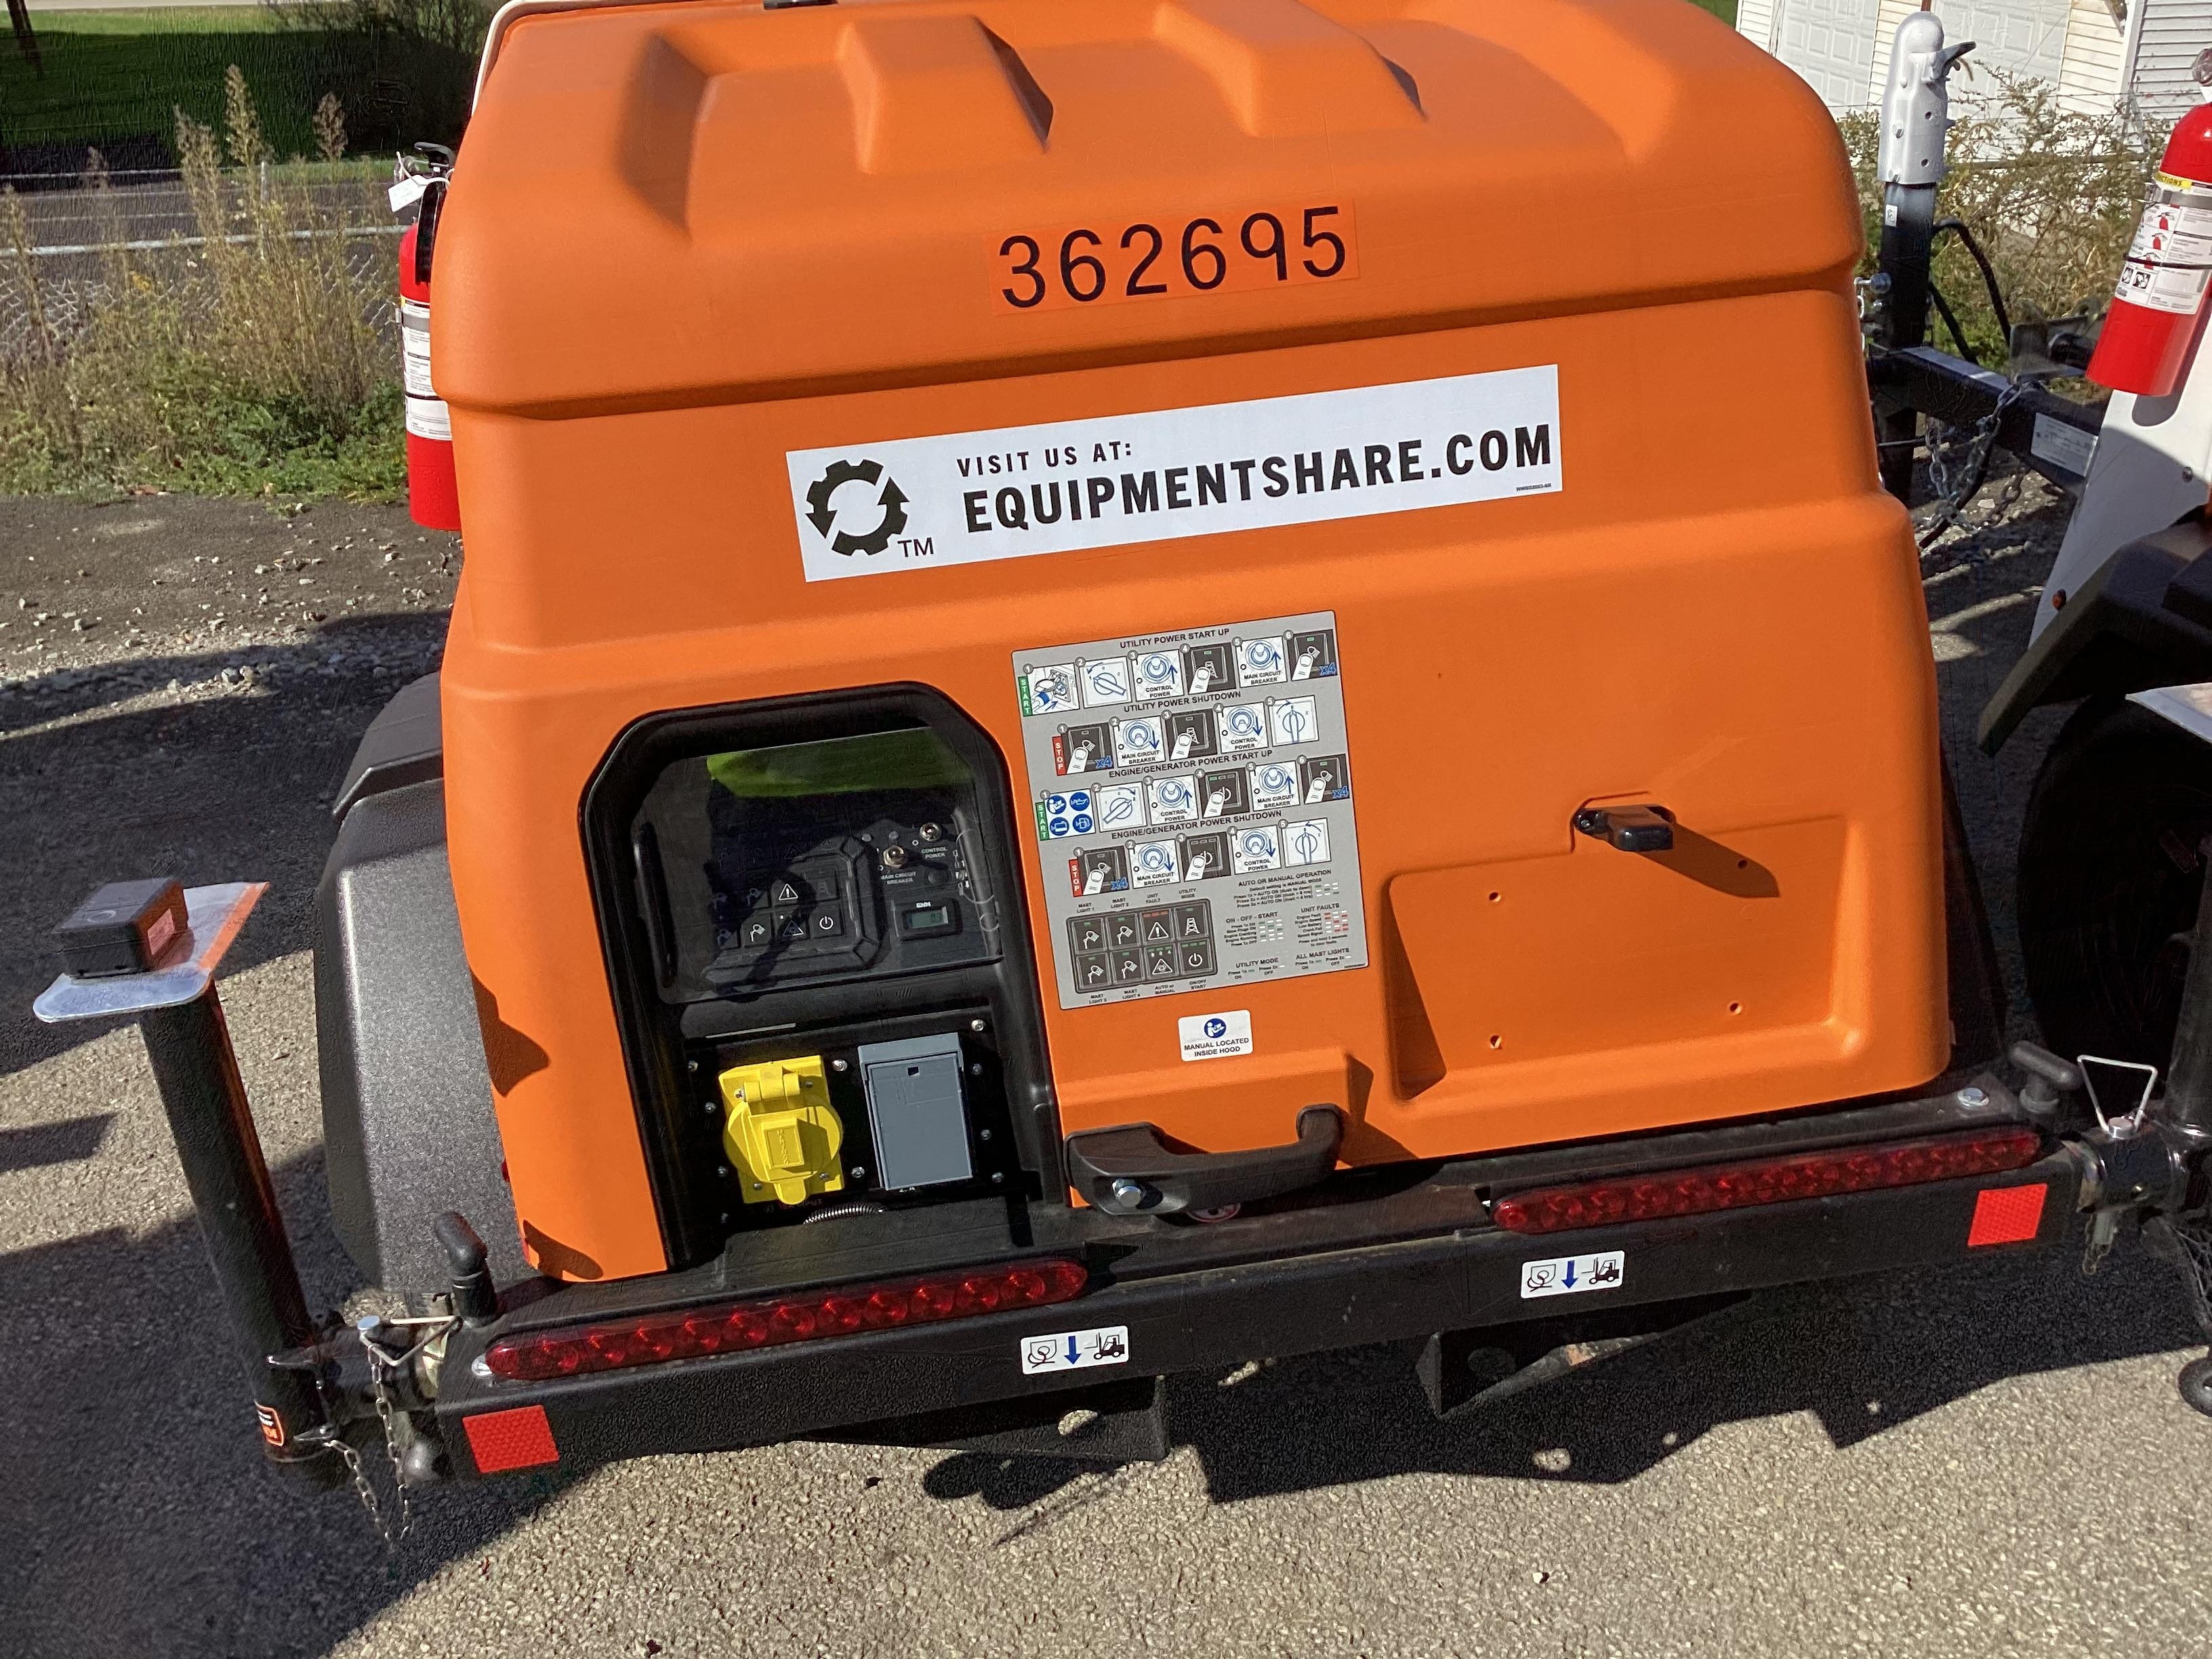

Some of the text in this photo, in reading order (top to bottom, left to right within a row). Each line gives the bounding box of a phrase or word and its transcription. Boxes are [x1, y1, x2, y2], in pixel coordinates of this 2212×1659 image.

[999, 205, 1345, 308] 362695
[957, 441, 1132, 477] VISIT US AT:
[963, 424, 1551, 533] EQUIPMENTSHARE.COM
[897, 537, 935, 558] TM
[1120, 638, 1151, 649] UTILITY
[1154, 634, 1186, 644] POWER
[1189, 630, 1216, 640] START
[1019, 679, 1031, 714] START
[1124, 691, 1241, 712] UTILITY POWER SHUTDOWN
[1055, 742, 1063, 770] STOP
[1095, 756, 1113, 769] x4
[1109, 760, 1196, 778] ENGINE/GENERATOR
[1198, 755, 1230, 765] POWER
[1232, 752, 1259, 762] START
[1038, 805, 1047, 838] START
[1111, 810, 1282, 840] ENGINE/GENERATOR POWER SHUTDOWN
[1071, 865, 1080, 891] STOP
[1111, 877, 1128, 890] x4
[1268, 875, 1294, 883] MANUAL
[1296, 869, 1332, 878] OPERATION
[1235, 960, 1259, 968] UTILITY
[1184, 1038, 1249, 1050] MANUAL LOCATED
[1194, 1046, 1240, 1057] INSIDE HOOD
